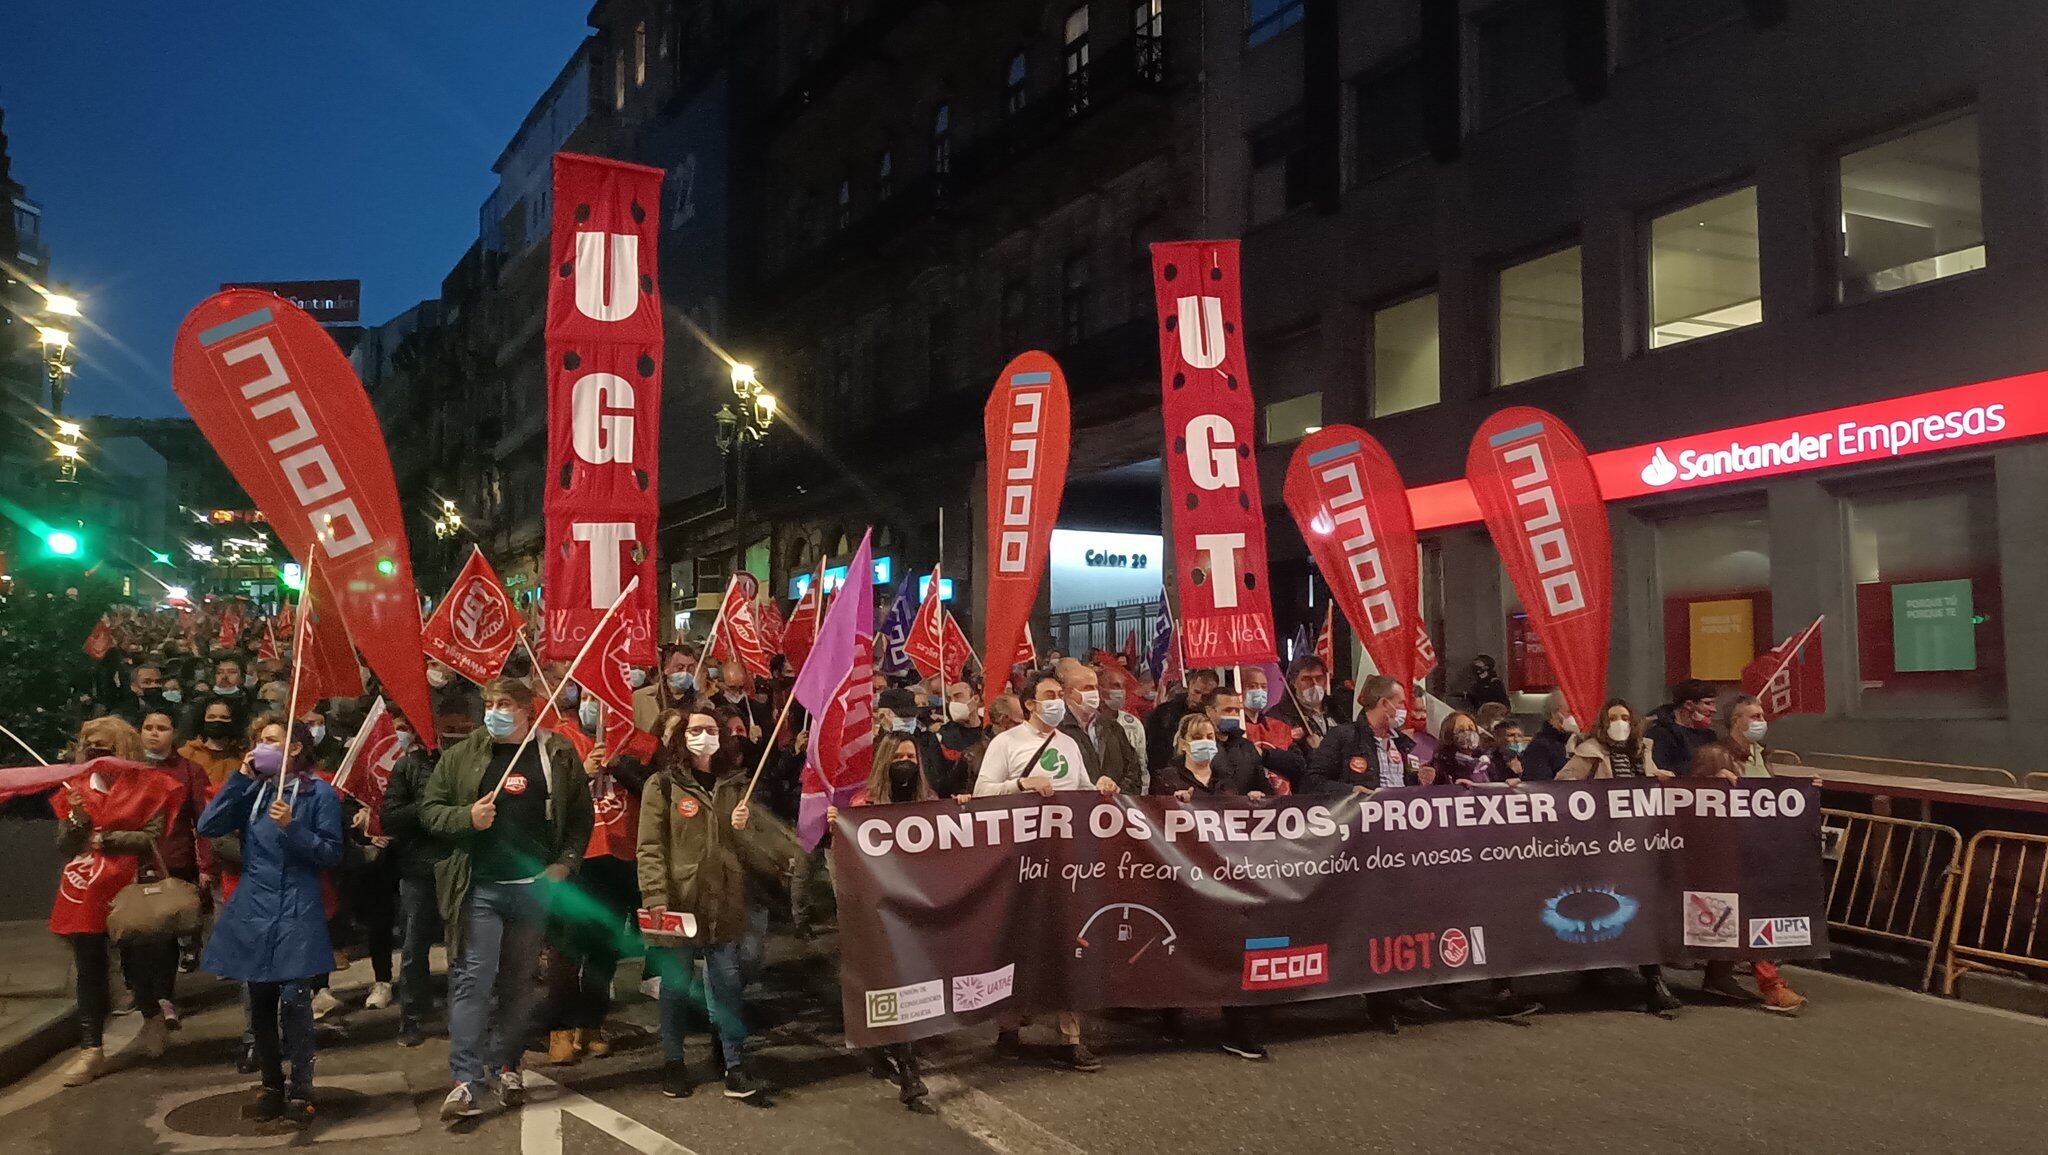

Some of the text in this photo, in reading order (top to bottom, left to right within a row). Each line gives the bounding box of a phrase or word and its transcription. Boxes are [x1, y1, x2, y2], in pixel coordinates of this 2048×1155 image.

[572, 231, 638, 609] UGT
[1176, 295, 1246, 609] UGT
[1679, 403, 2006, 481] Santander Empresas
[1130, 552, 1148, 568] 20
[857, 786, 1807, 857] CONTER OS PREZOS, PROTEXER O EMPREGO
[1018, 828, 1686, 894] Hai que frear a deterioración das nosas condicións de vida
[1773, 918, 1809, 933] UPTA
[1074, 947, 1083, 958] E
[1168, 944, 1176, 956] F
[1250, 952, 1323, 982] CCOO
[1368, 932, 1436, 974] UGT
